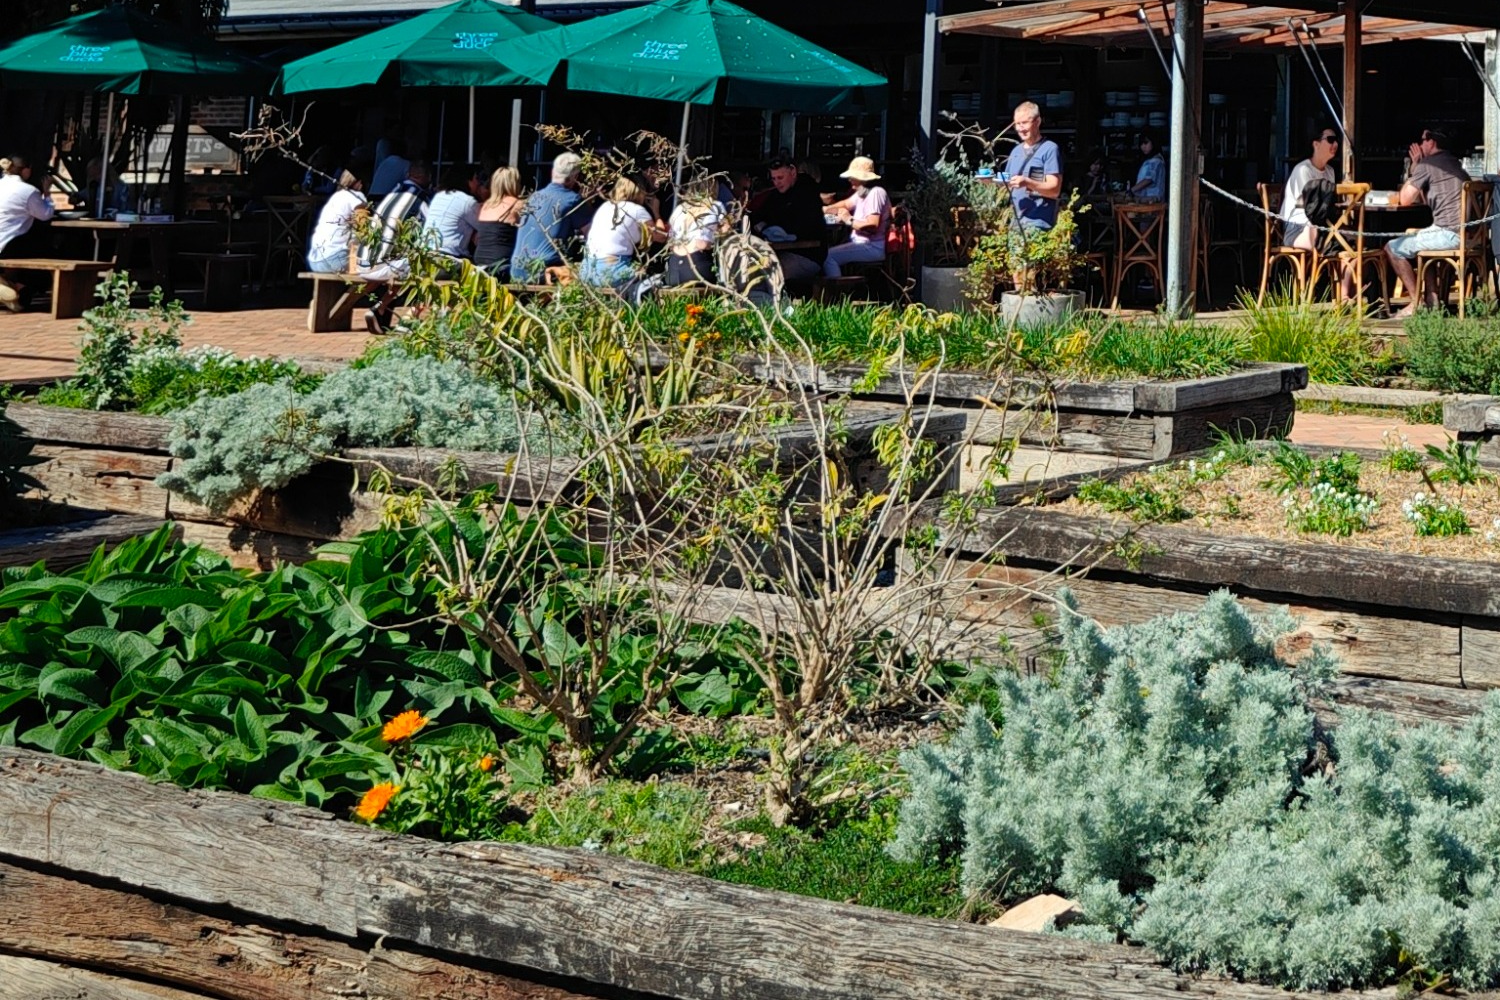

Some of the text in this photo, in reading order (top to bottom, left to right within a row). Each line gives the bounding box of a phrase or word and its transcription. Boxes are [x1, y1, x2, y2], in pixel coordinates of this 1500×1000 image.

[70, 44, 111, 52] three
[644, 40, 688, 50] three
[645, 44, 679, 55] blue
[59, 52, 104, 62] ducks
[69, 49, 103, 58] blue
[632, 50, 680, 61] ducks
